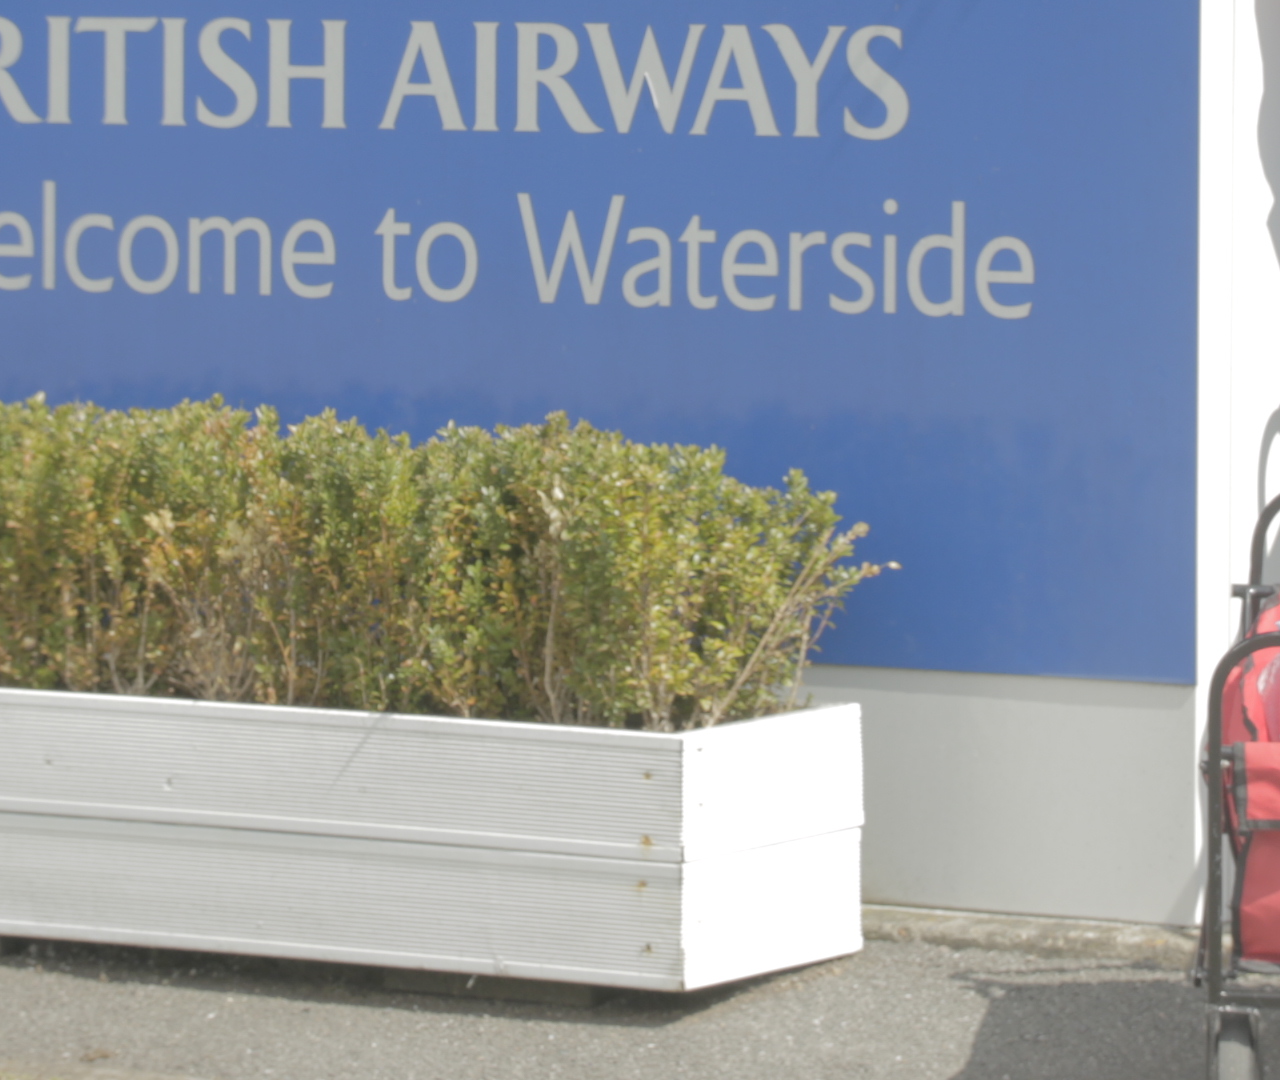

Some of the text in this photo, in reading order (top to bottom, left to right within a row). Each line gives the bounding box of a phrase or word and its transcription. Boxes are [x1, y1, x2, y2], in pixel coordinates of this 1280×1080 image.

[377, 19, 911, 141] AIRWAYS
[373, 206, 479, 303] to
[516, 191, 1036, 320] Waterside
